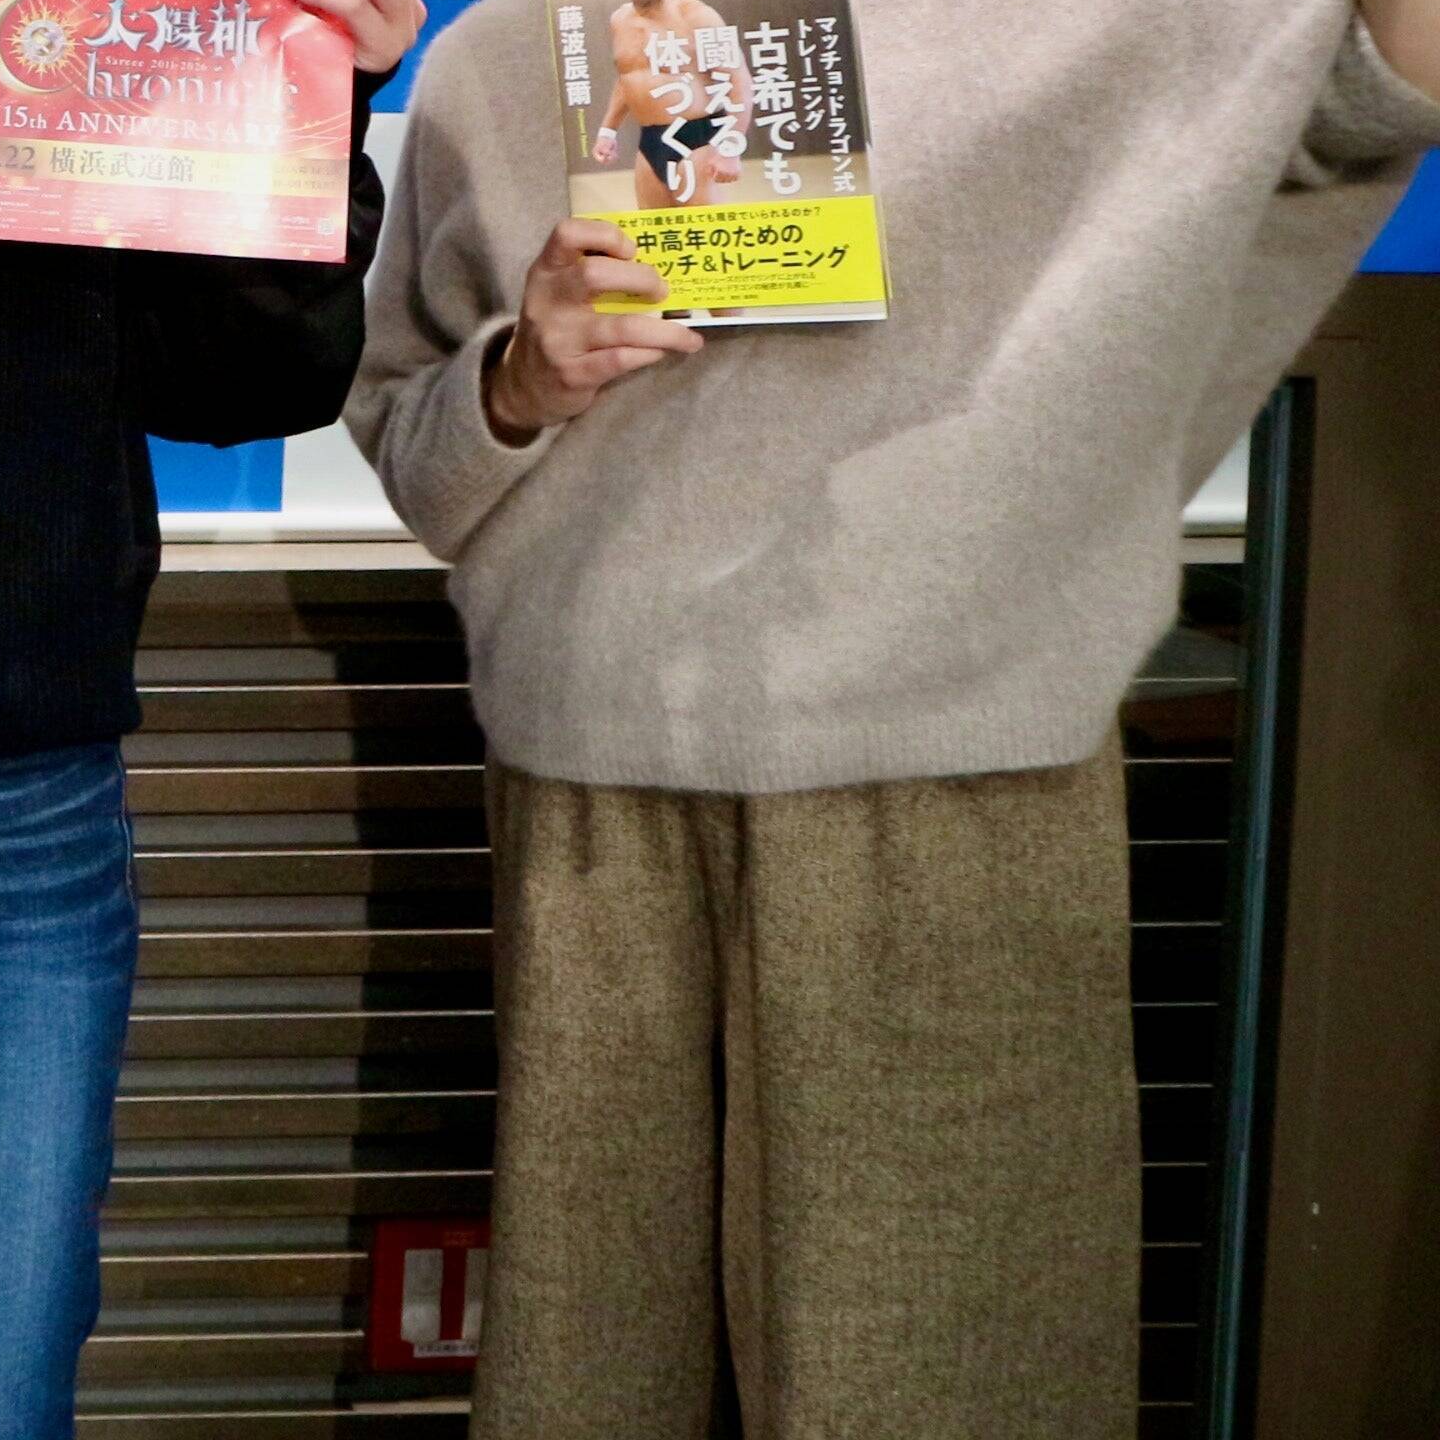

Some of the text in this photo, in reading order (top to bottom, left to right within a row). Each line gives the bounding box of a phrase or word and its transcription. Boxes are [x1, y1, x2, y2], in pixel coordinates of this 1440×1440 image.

[557, 5, 592, 107] 藤波辰爾
[694, 25, 748, 158] 闘える
[744, 22, 803, 196] 古希でも
[797, 18, 826, 131] トレーニング
[3, 105, 48, 130] 15th
[49, 146, 196, 184] 横浜武道館
[643, 30, 697, 203] 体づくり
[636, 224, 804, 254] 中高年のための
